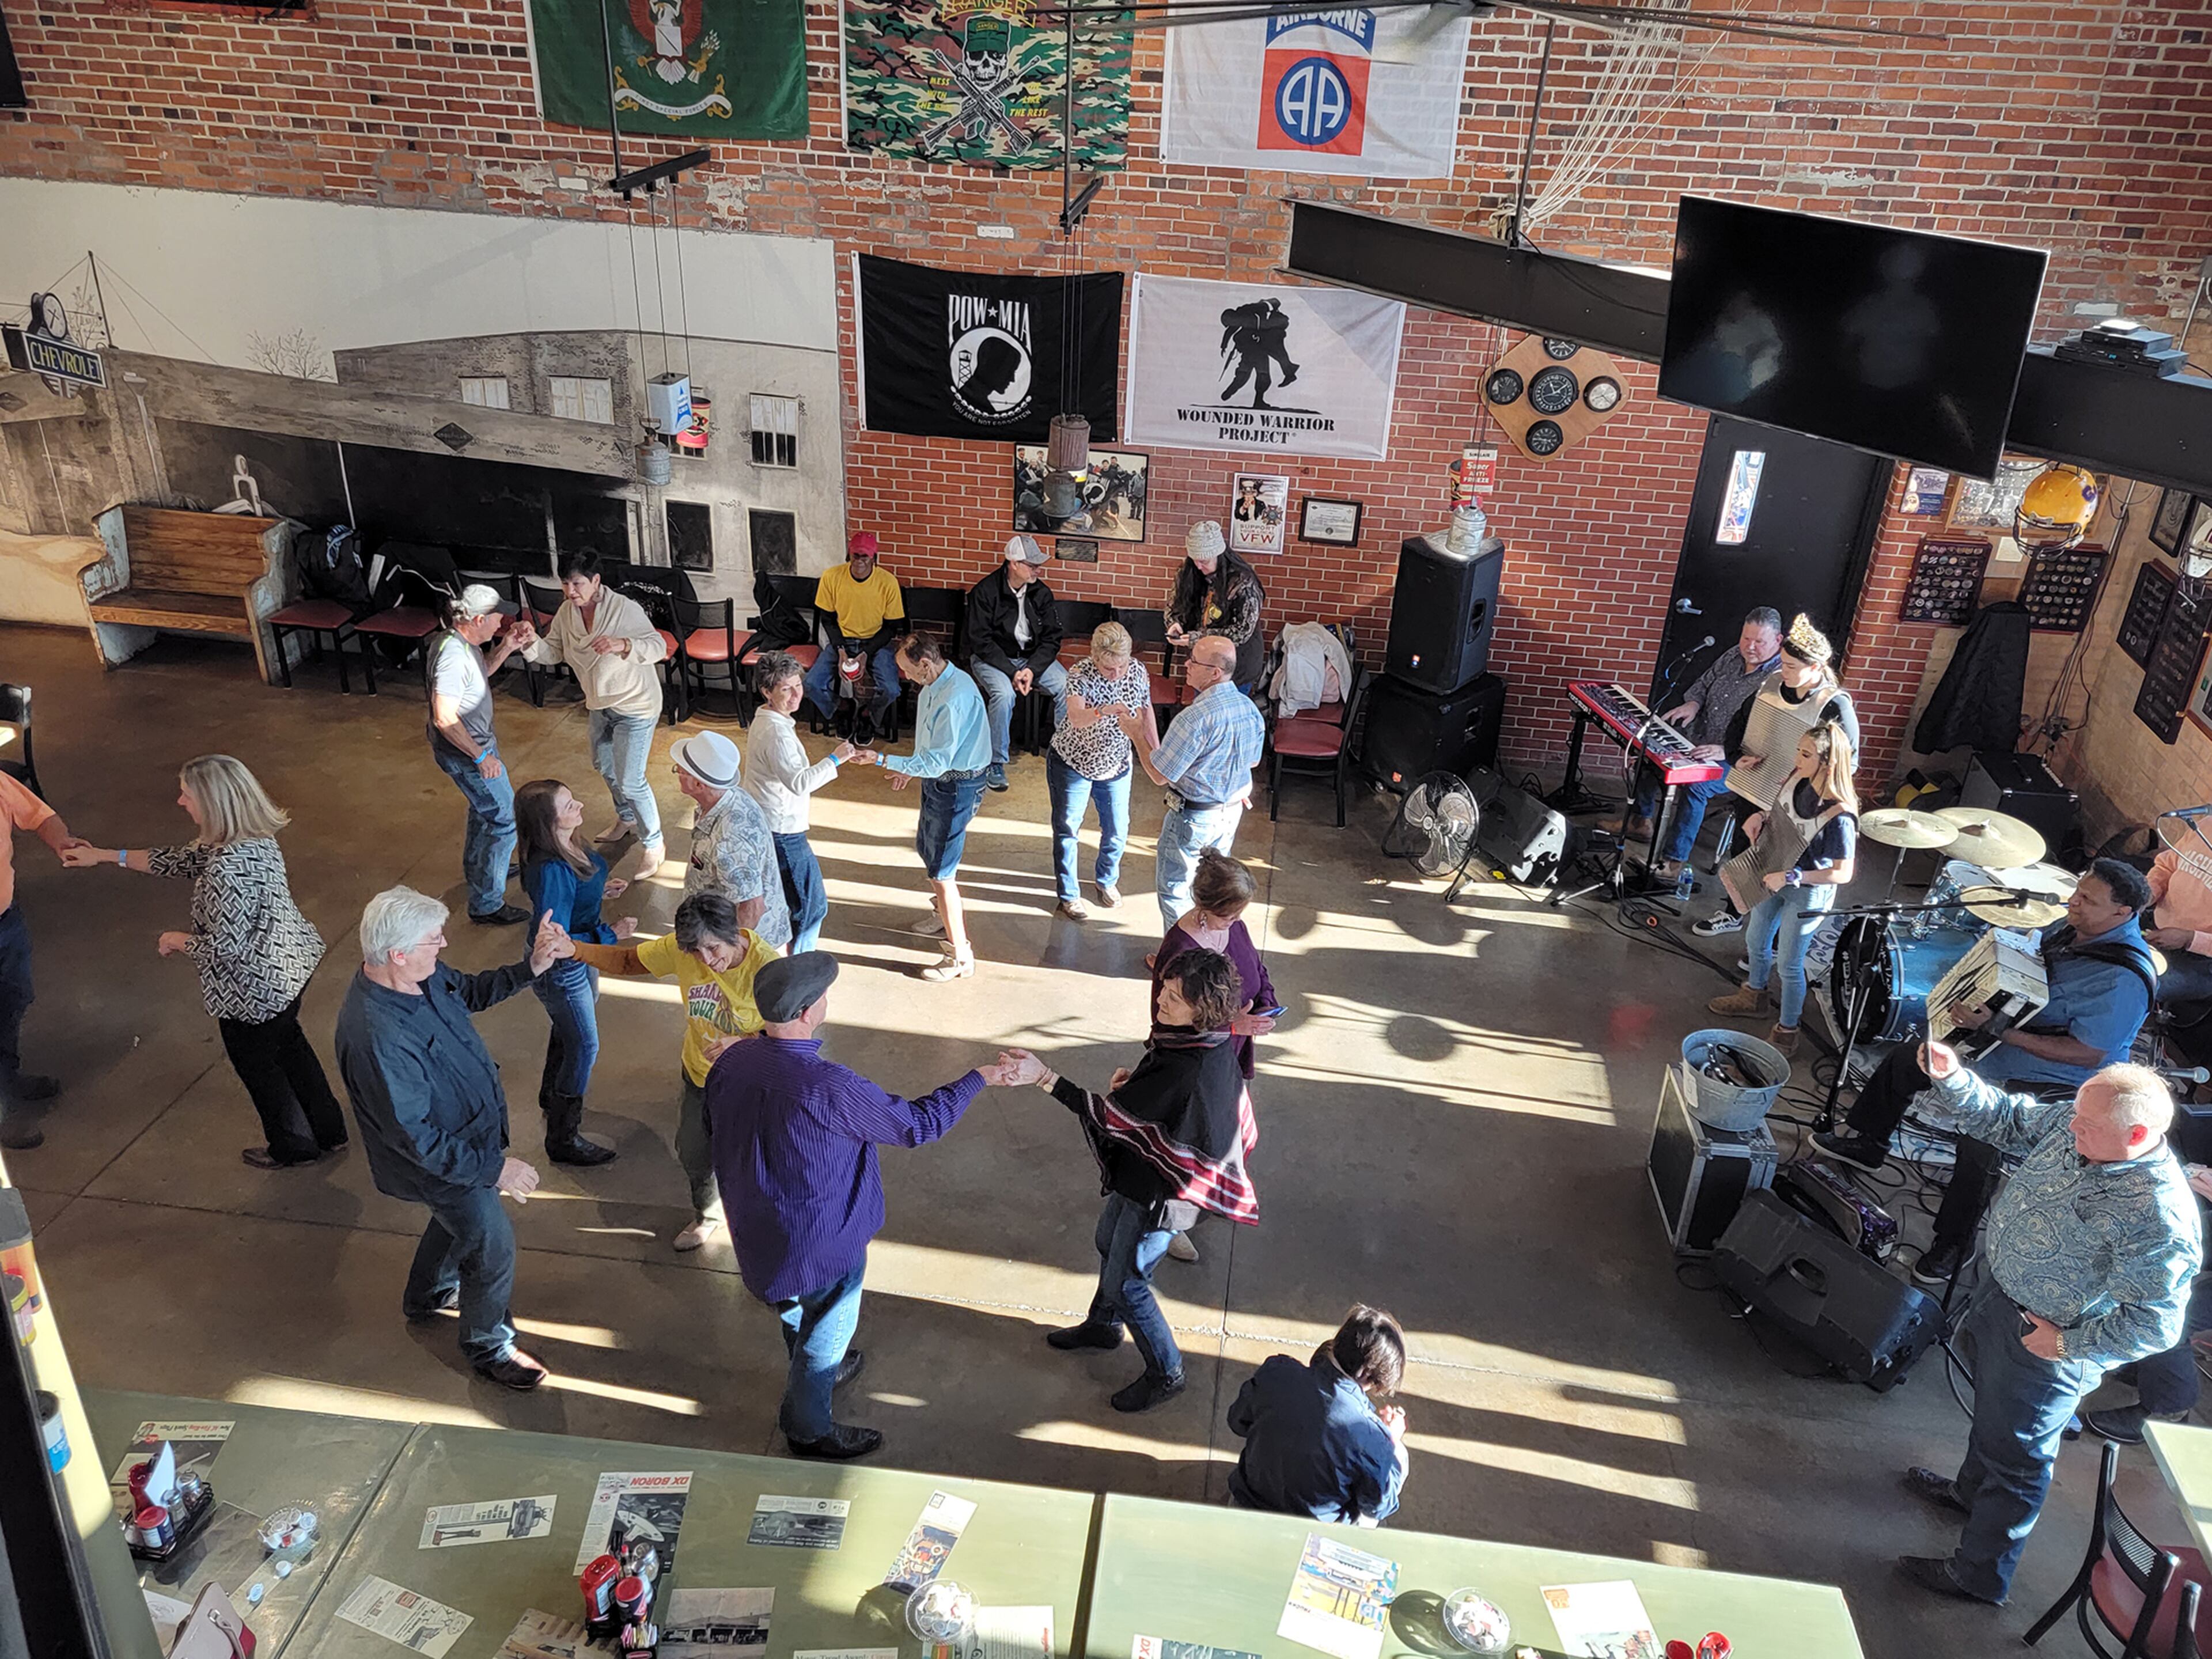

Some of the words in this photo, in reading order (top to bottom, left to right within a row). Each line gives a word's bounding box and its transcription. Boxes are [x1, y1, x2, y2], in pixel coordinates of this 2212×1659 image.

[930, 77, 950, 85] MESS
[927, 90, 948, 99] WITH
[1282, 66, 1345, 138] AA
[1010, 108, 1026, 117] THE
[1028, 108, 1048, 117] REST
[948, 293, 988, 349] POW
[998, 299, 1032, 357] MIA
[29, 341, 101, 380] CHEVROLET
[952, 401, 964, 414] YOU
[963, 410, 977, 423] ARE
[978, 417, 991, 426] NOT
[1177, 408, 1254, 426] WOUNDED
[1260, 414, 1335, 431] WARRIOR
[1218, 426, 1290, 444] PROJECT
[1240, 532, 1275, 544] VFW
[689, 999, 717, 1021] YOUR
[630, 1477, 671, 1486] BORON
[671, 1476, 690, 1486] DX
